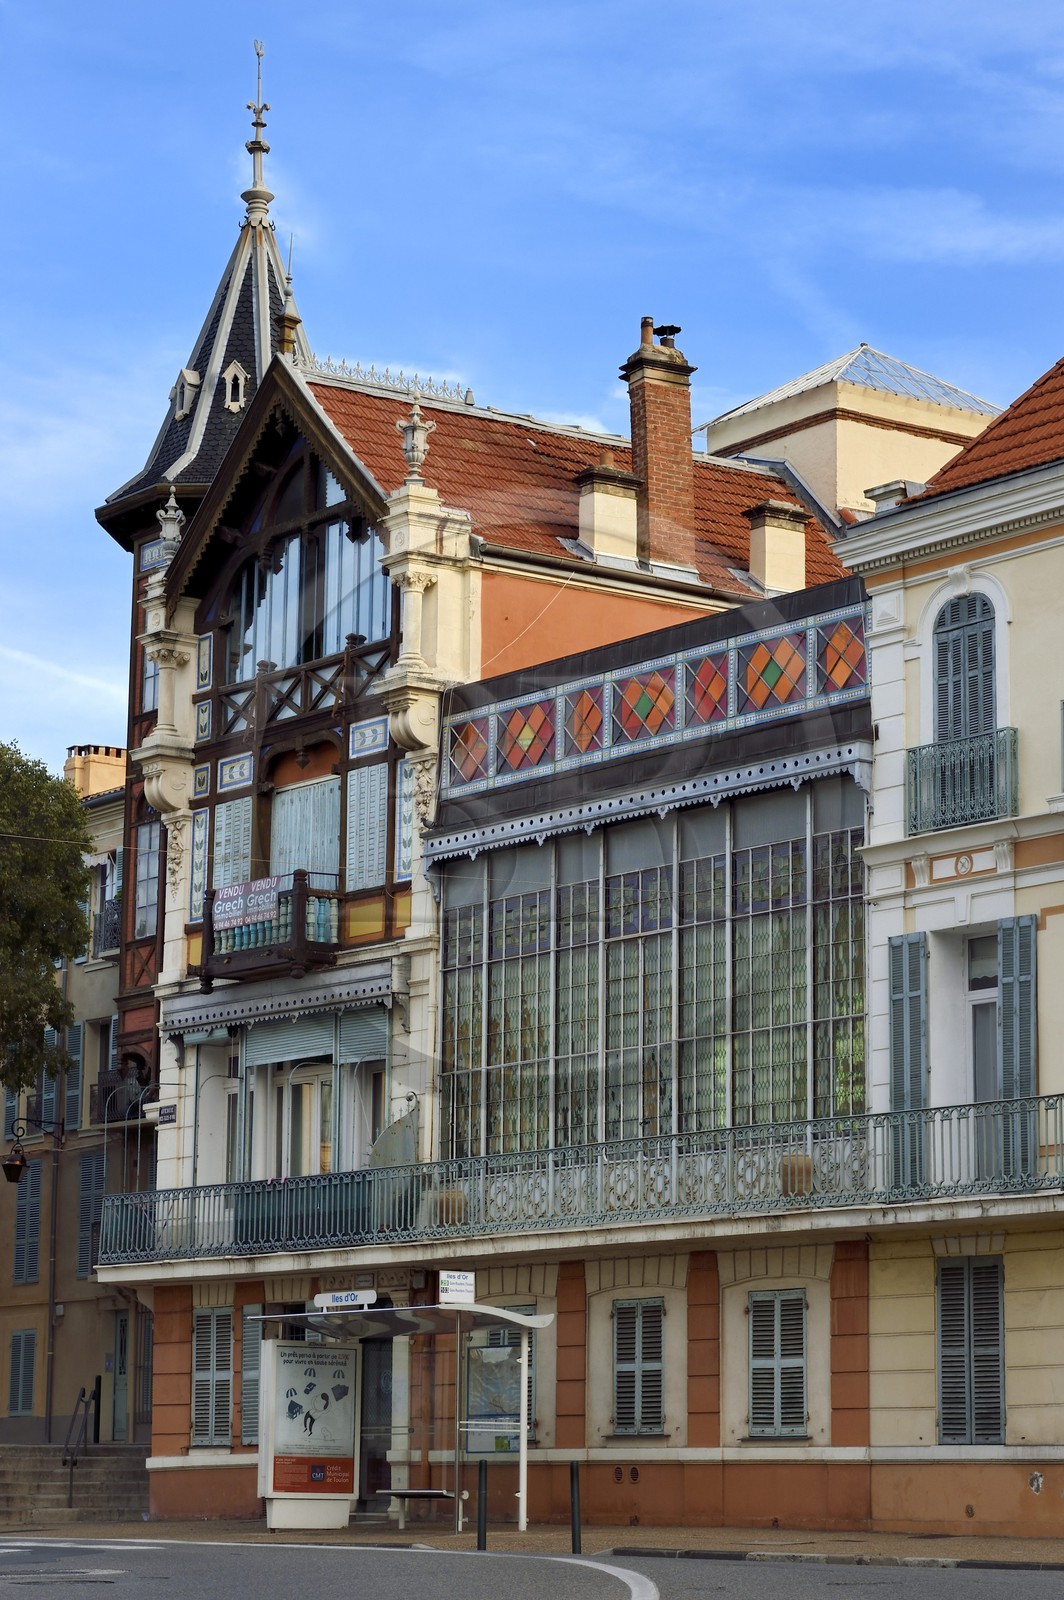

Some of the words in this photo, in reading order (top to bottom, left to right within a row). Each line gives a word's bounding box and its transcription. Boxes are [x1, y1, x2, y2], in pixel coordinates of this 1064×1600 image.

[219, 884, 245, 899] VENDU
[251, 876, 278, 892] VENDU
[214, 896, 243, 914] Grech
[246, 889, 276, 907] Grech
[331, 1294, 343, 1303] Iles
[344, 1293, 359, 1302] d'Or
